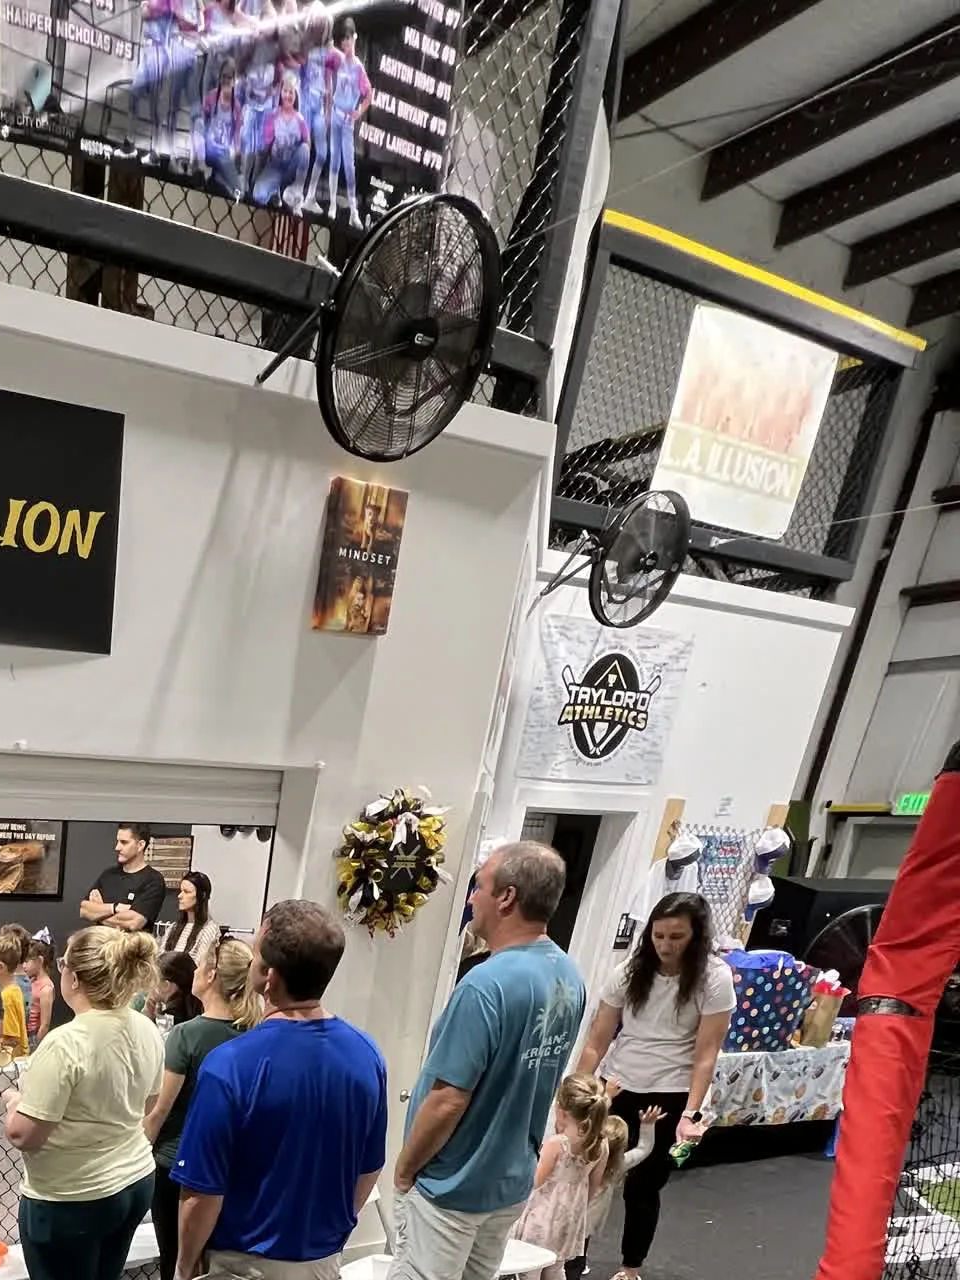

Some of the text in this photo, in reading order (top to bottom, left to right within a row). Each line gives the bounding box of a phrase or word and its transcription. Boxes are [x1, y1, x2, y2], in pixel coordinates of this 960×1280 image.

[56, 20, 111, 54] NICHOLAS
[359, 121, 386, 148] AVERY
[704, 440, 797, 497] ILLUSION
[338, 547, 391, 565] MINDSET
[568, 684, 651, 711] TAYLOR'D
[559, 704, 648, 729] ATHLETICS
[13, 832, 24, 840] THE
[24, 832, 37, 840] DAY
[36, 833, 56, 841] BEFORE
